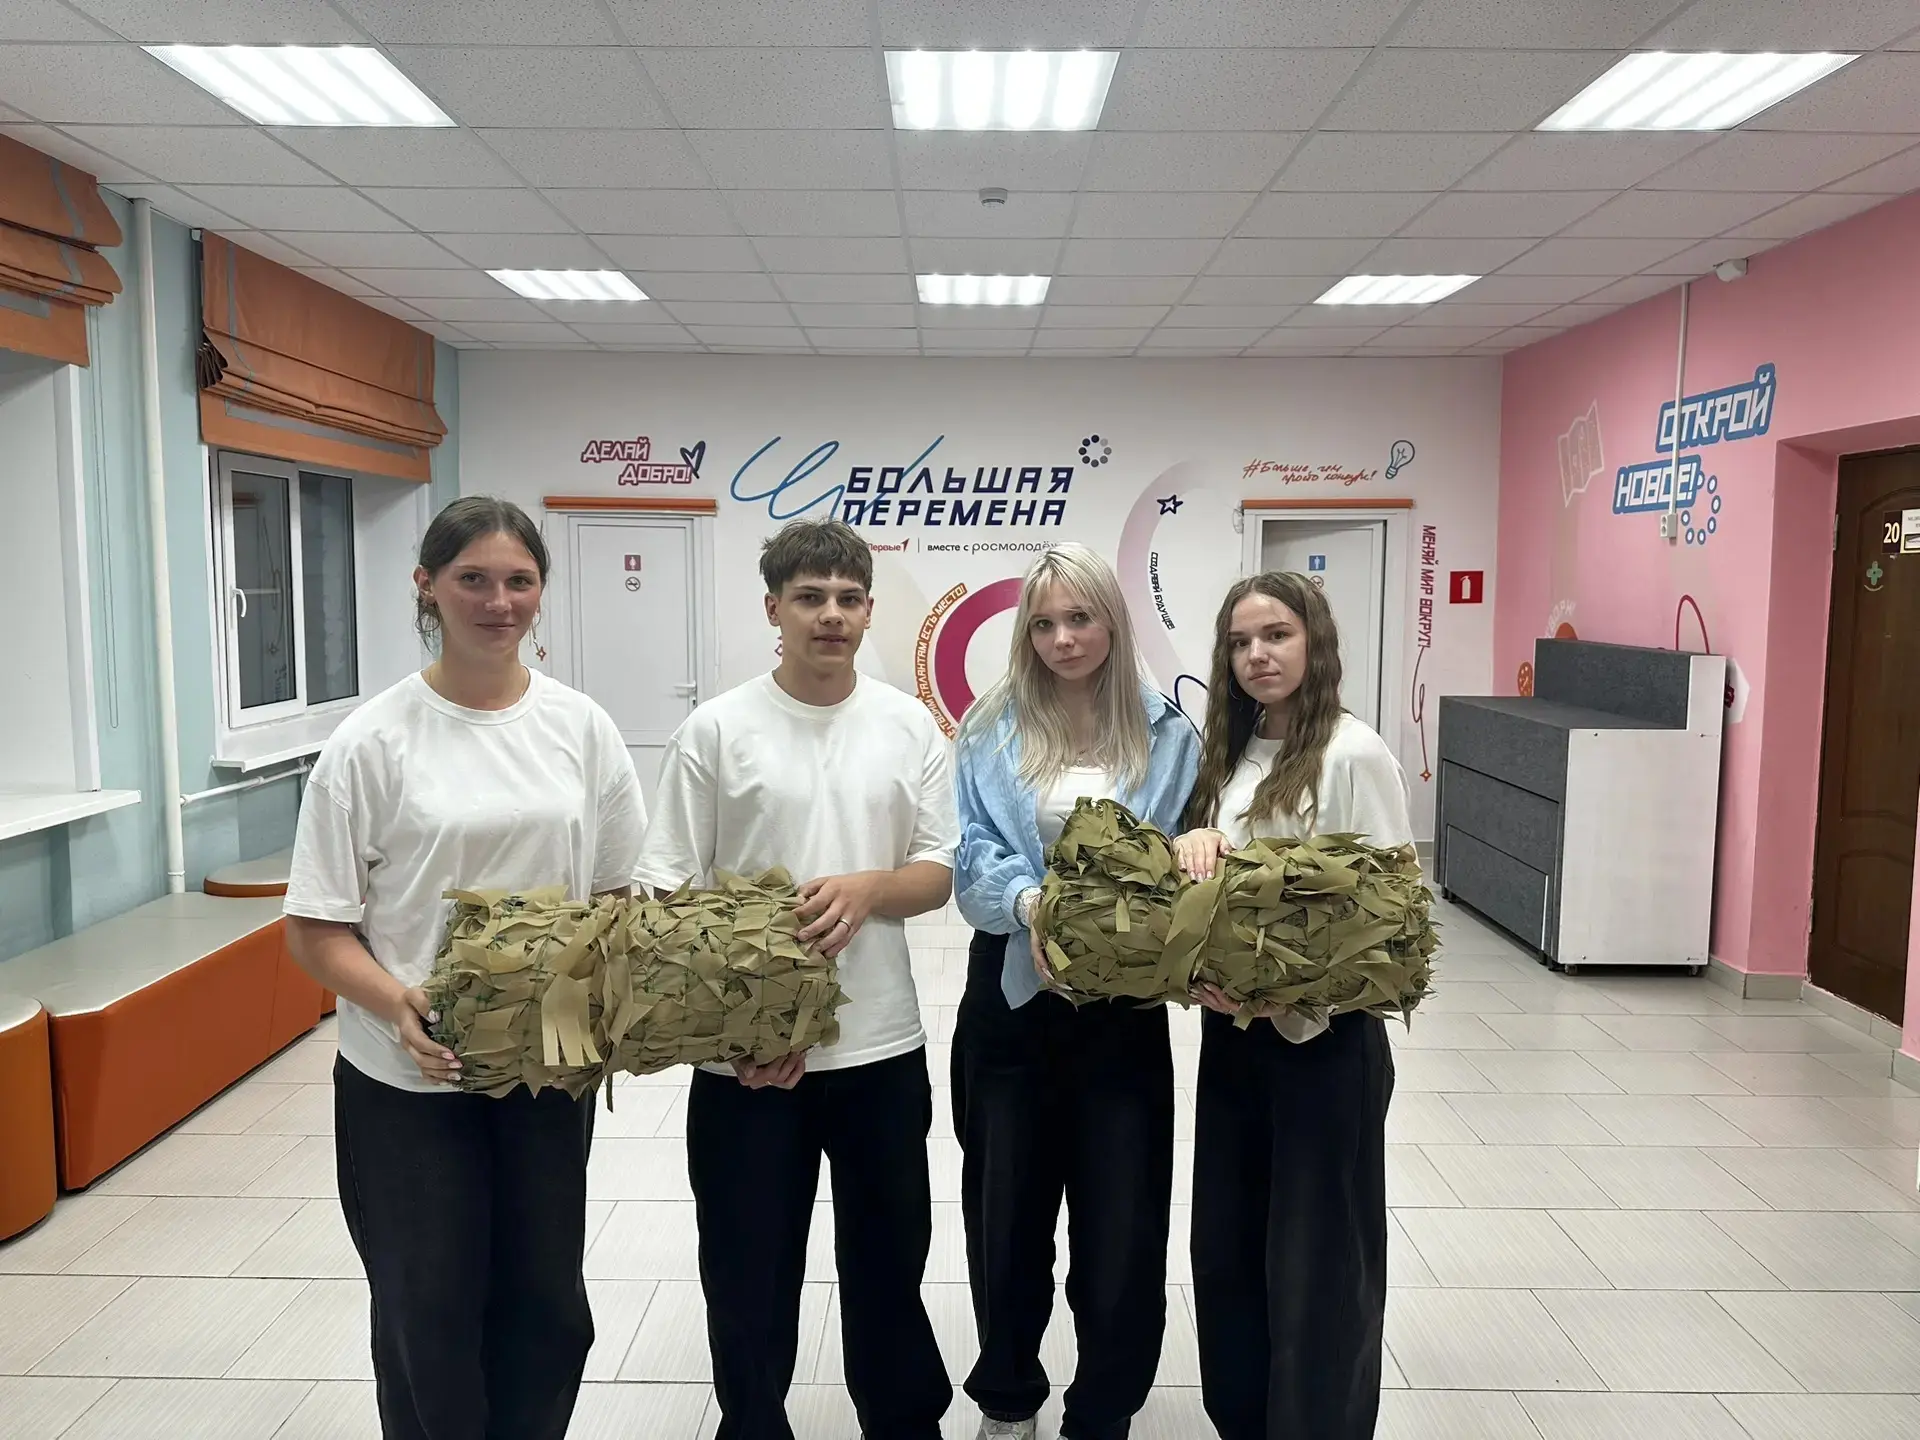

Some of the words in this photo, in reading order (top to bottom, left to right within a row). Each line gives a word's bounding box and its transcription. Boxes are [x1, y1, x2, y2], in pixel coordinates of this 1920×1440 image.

[1657, 371, 1772, 447] ОТКРОЙ
[581, 437, 650, 462] ДЕЛАЙ
[618, 463, 692, 485] ДОБРО!
[846, 467, 1074, 493] БОЛЬШАЯ
[1615, 462, 1698, 508] НОВОЕ!
[842, 500, 1067, 526] ПЕРЕМЕНА
[1421, 524, 1440, 566] МЕНЯЙ
[1883, 521, 1900, 544] 20
[927, 543, 960, 552] вместе
[963, 544, 969, 552] с
[971, 540, 1060, 555] росмолодё
[1420, 568, 1435, 595] МИР
[933, 584, 966, 616] МЕСТО!
[920, 616, 938, 641] ЕСТЬ
[916, 641, 930, 698] ТАЛАНТАМ
